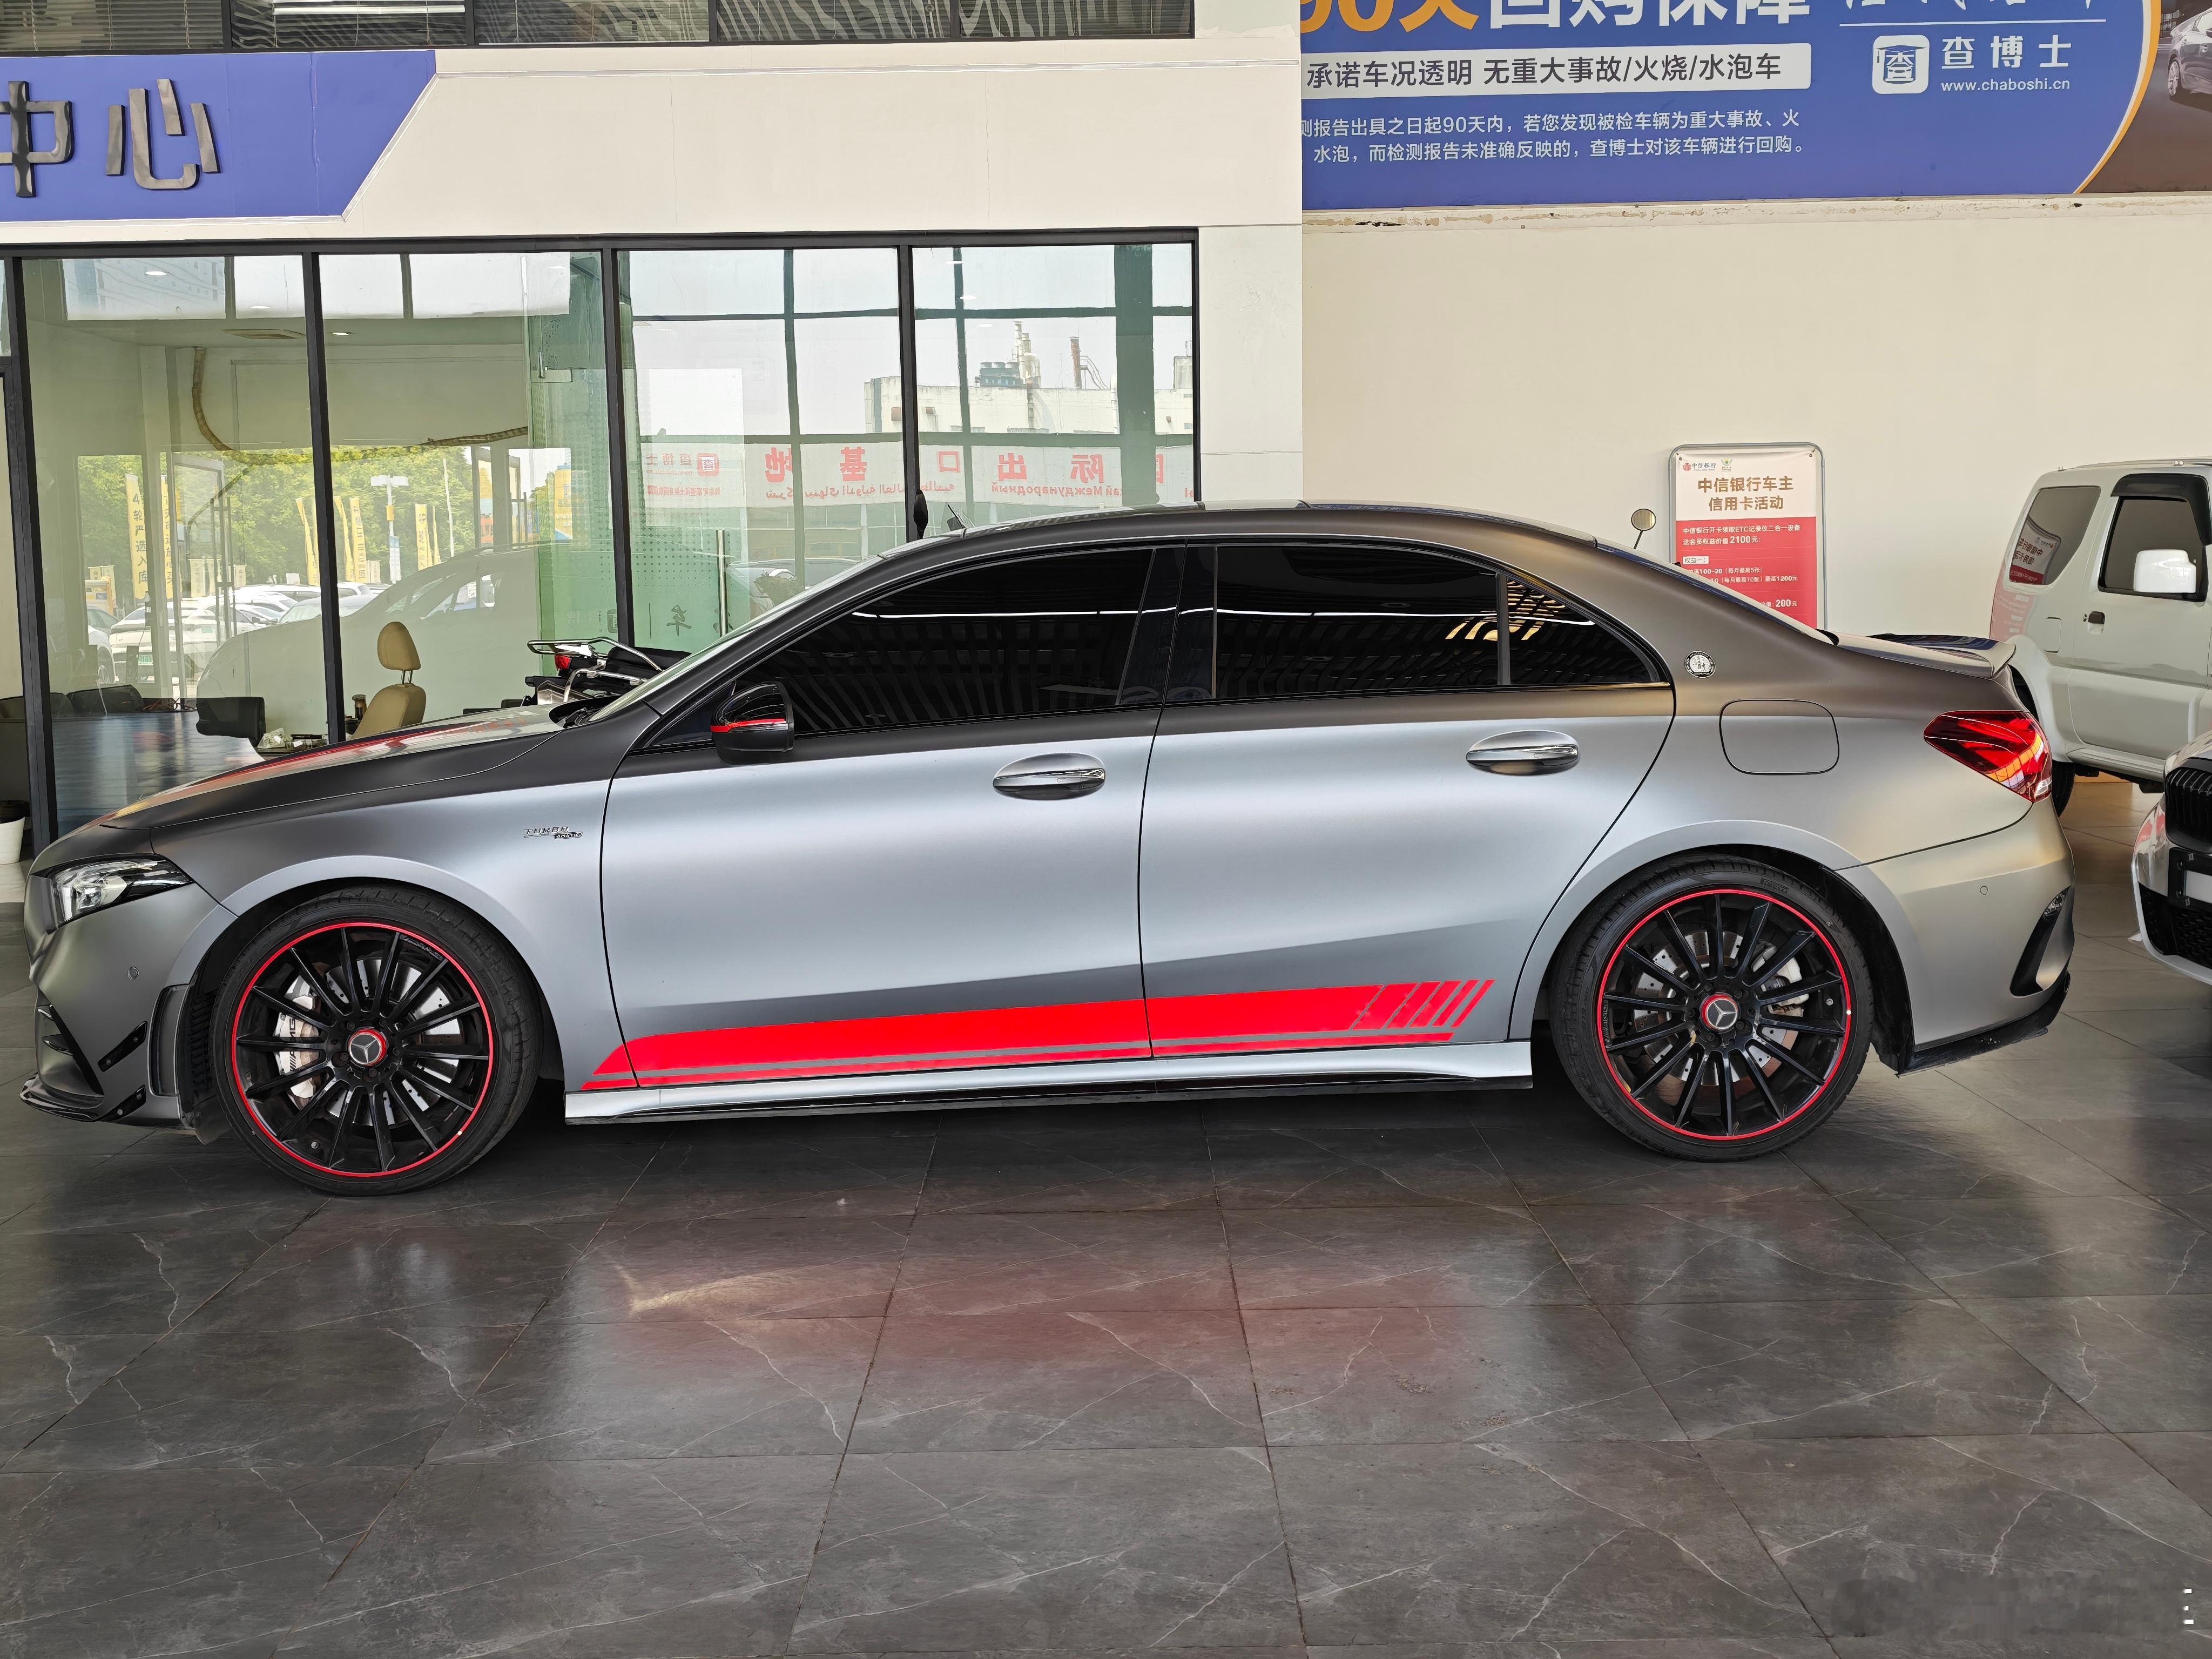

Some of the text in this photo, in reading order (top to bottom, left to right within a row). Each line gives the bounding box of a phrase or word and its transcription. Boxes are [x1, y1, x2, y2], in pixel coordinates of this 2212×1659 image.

[1941, 36, 2072, 69] 查博士
[1307, 53, 1781, 89] 承诺车况透明 无重大事故/火烧/水泡车
[1941, 77, 2071, 92] www.chaboshi.cn
[0, 78, 220, 197] 中心
[1698, 476, 1794, 493] 中信银行车主
[1709, 495, 1784, 511] 信用卡活动
[524, 826, 569, 835] TURBO
